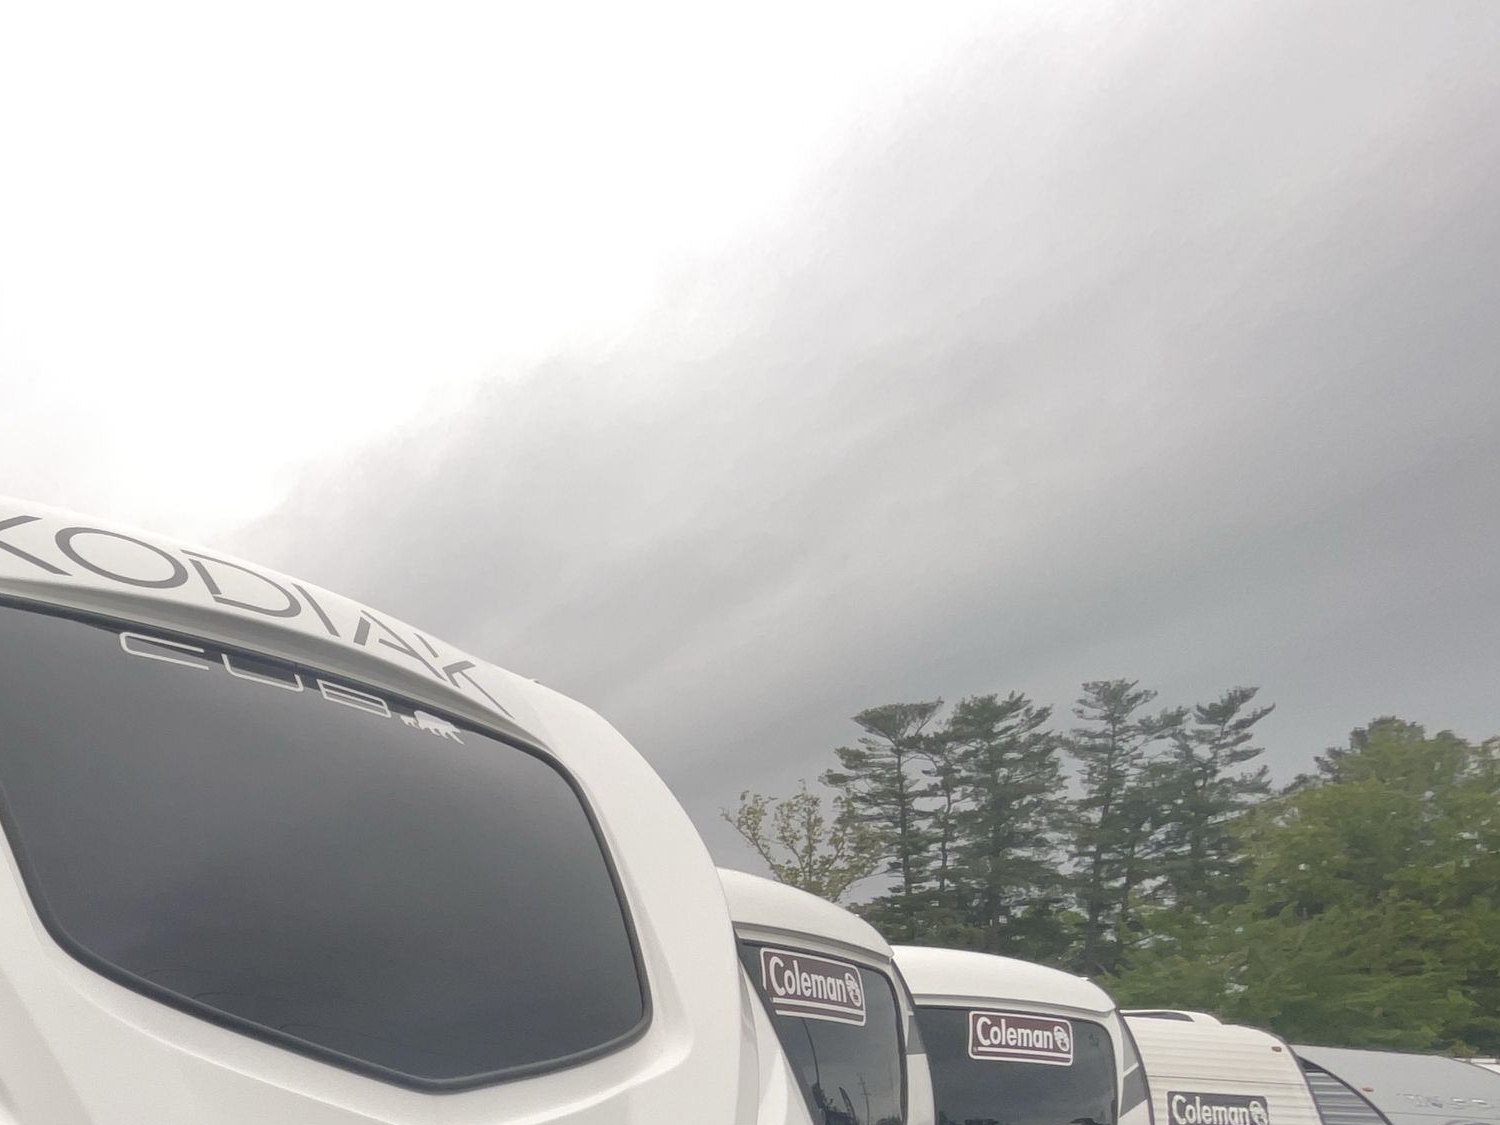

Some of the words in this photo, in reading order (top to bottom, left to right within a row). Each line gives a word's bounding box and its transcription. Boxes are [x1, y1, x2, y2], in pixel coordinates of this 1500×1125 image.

[120, 632, 391, 718] CUB
[769, 956, 848, 1003] Coleman
[976, 1016, 1054, 1050] Coleman
[1172, 1094, 1250, 1125] Coleman
